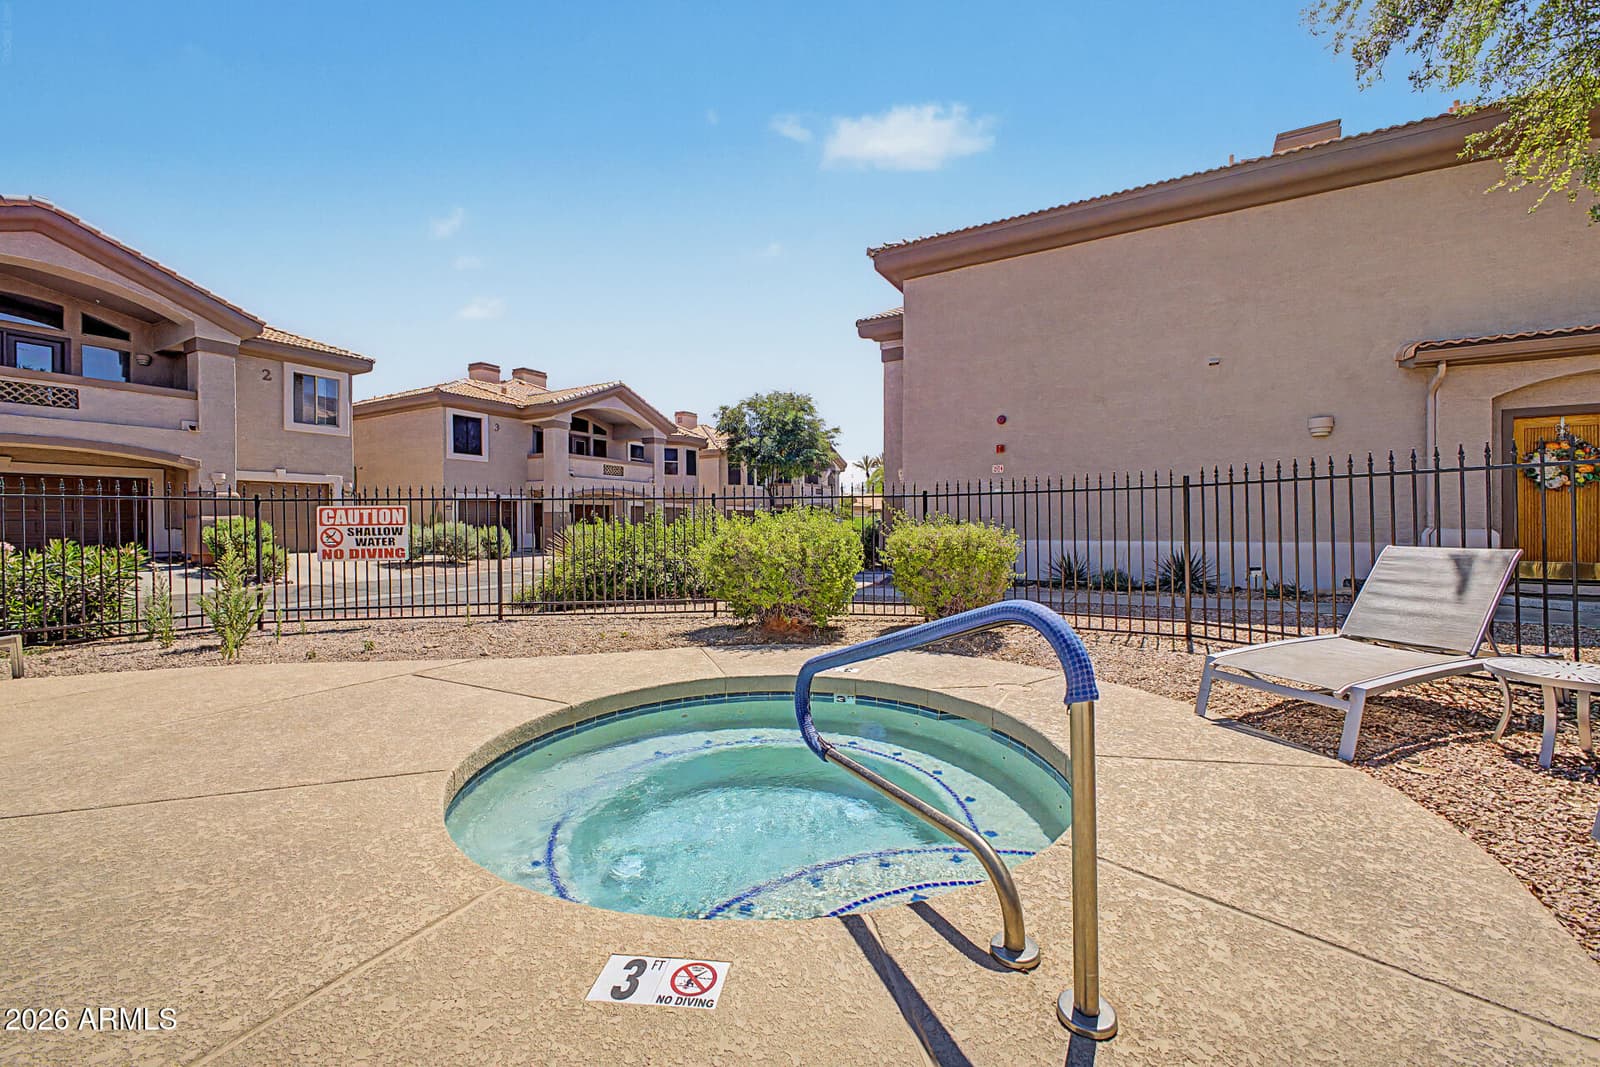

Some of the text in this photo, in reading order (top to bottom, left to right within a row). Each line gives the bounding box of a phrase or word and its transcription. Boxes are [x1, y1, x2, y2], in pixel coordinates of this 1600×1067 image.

[261, 368, 272, 382] 2
[494, 422, 501, 432] 3
[321, 508, 404, 525] CAUTION
[346, 526, 404, 537] SHALLOW
[355, 537, 396, 547] WATER
[322, 547, 406, 560] NO DIVING
[836, 695, 846, 703] 3
[610, 958, 667, 1001] 3 FT
[655, 994, 715, 1009] NO DIVING
